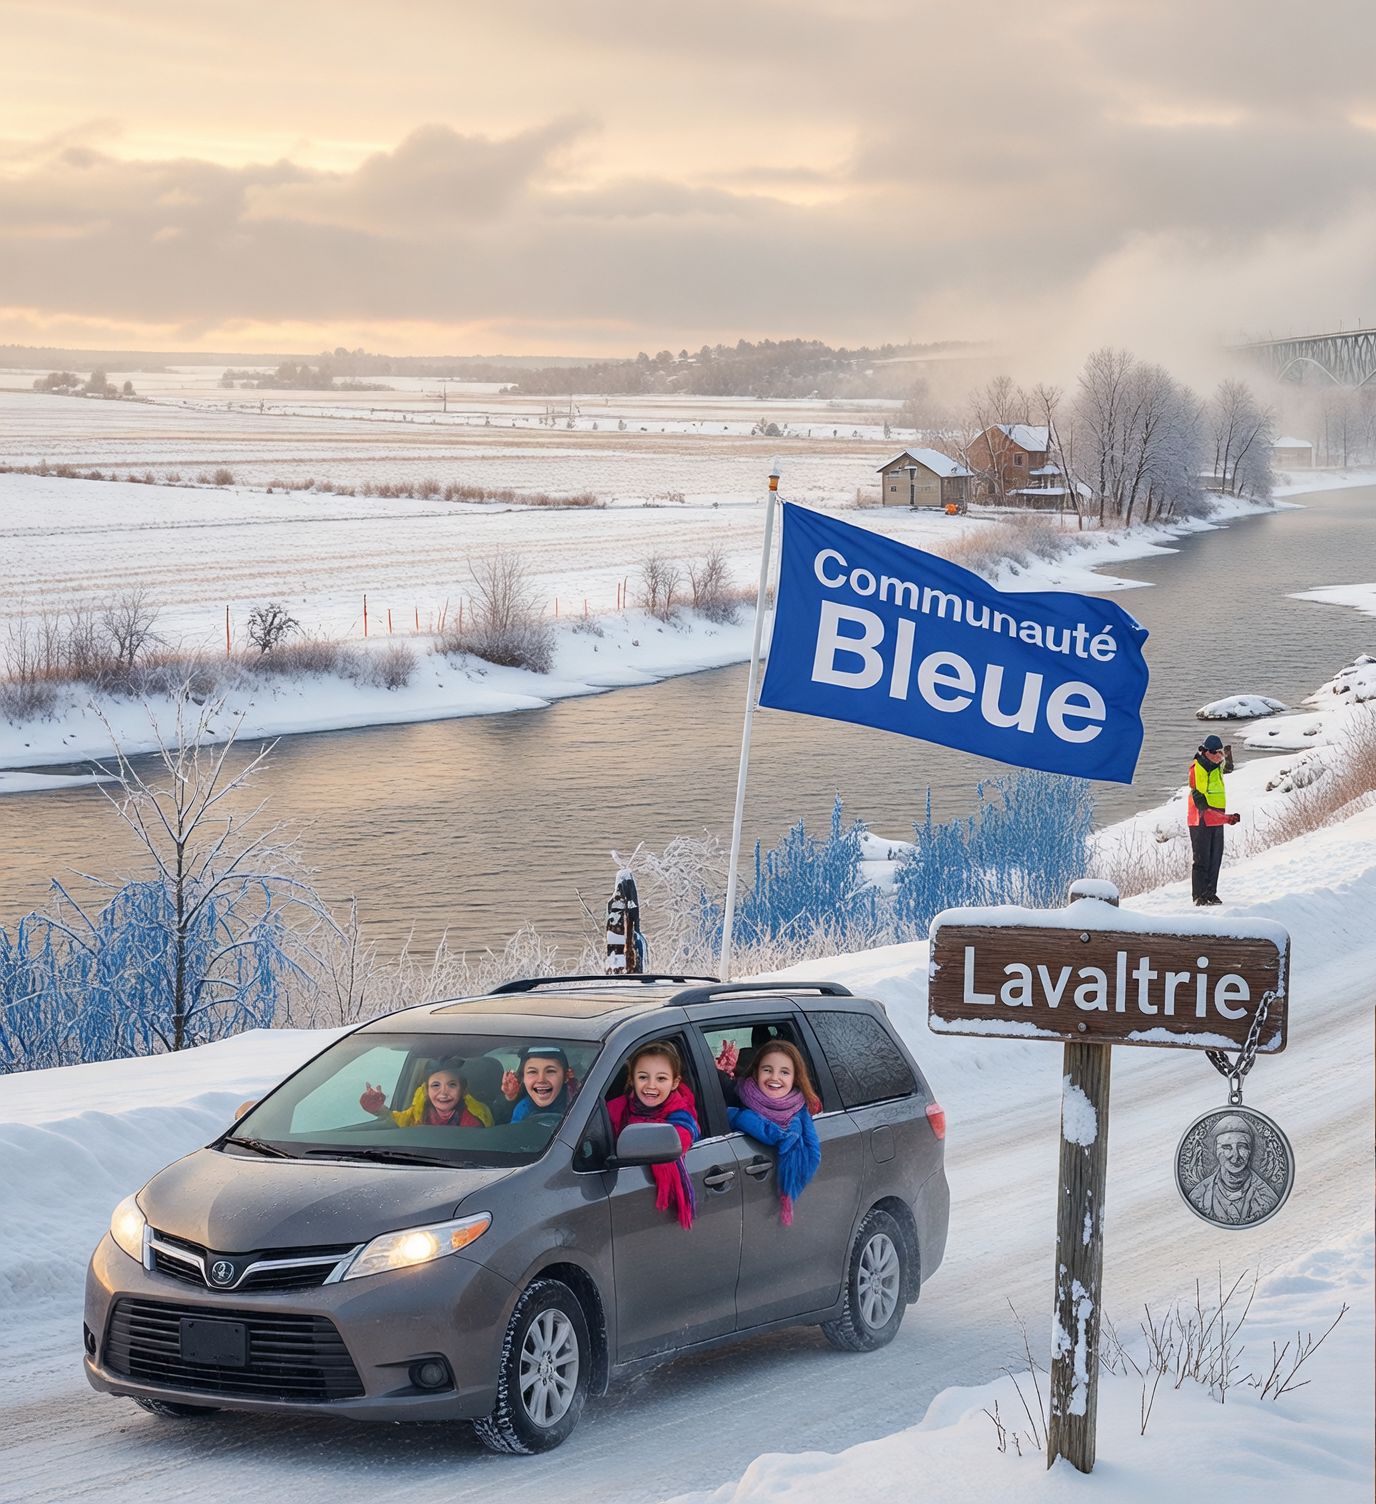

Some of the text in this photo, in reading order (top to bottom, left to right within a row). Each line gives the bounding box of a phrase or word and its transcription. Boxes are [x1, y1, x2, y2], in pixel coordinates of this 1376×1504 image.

[813, 548, 1118, 662] Communauté
[811, 600, 1107, 744] Bleue
[963, 946, 1251, 1021] Lavaltrie
